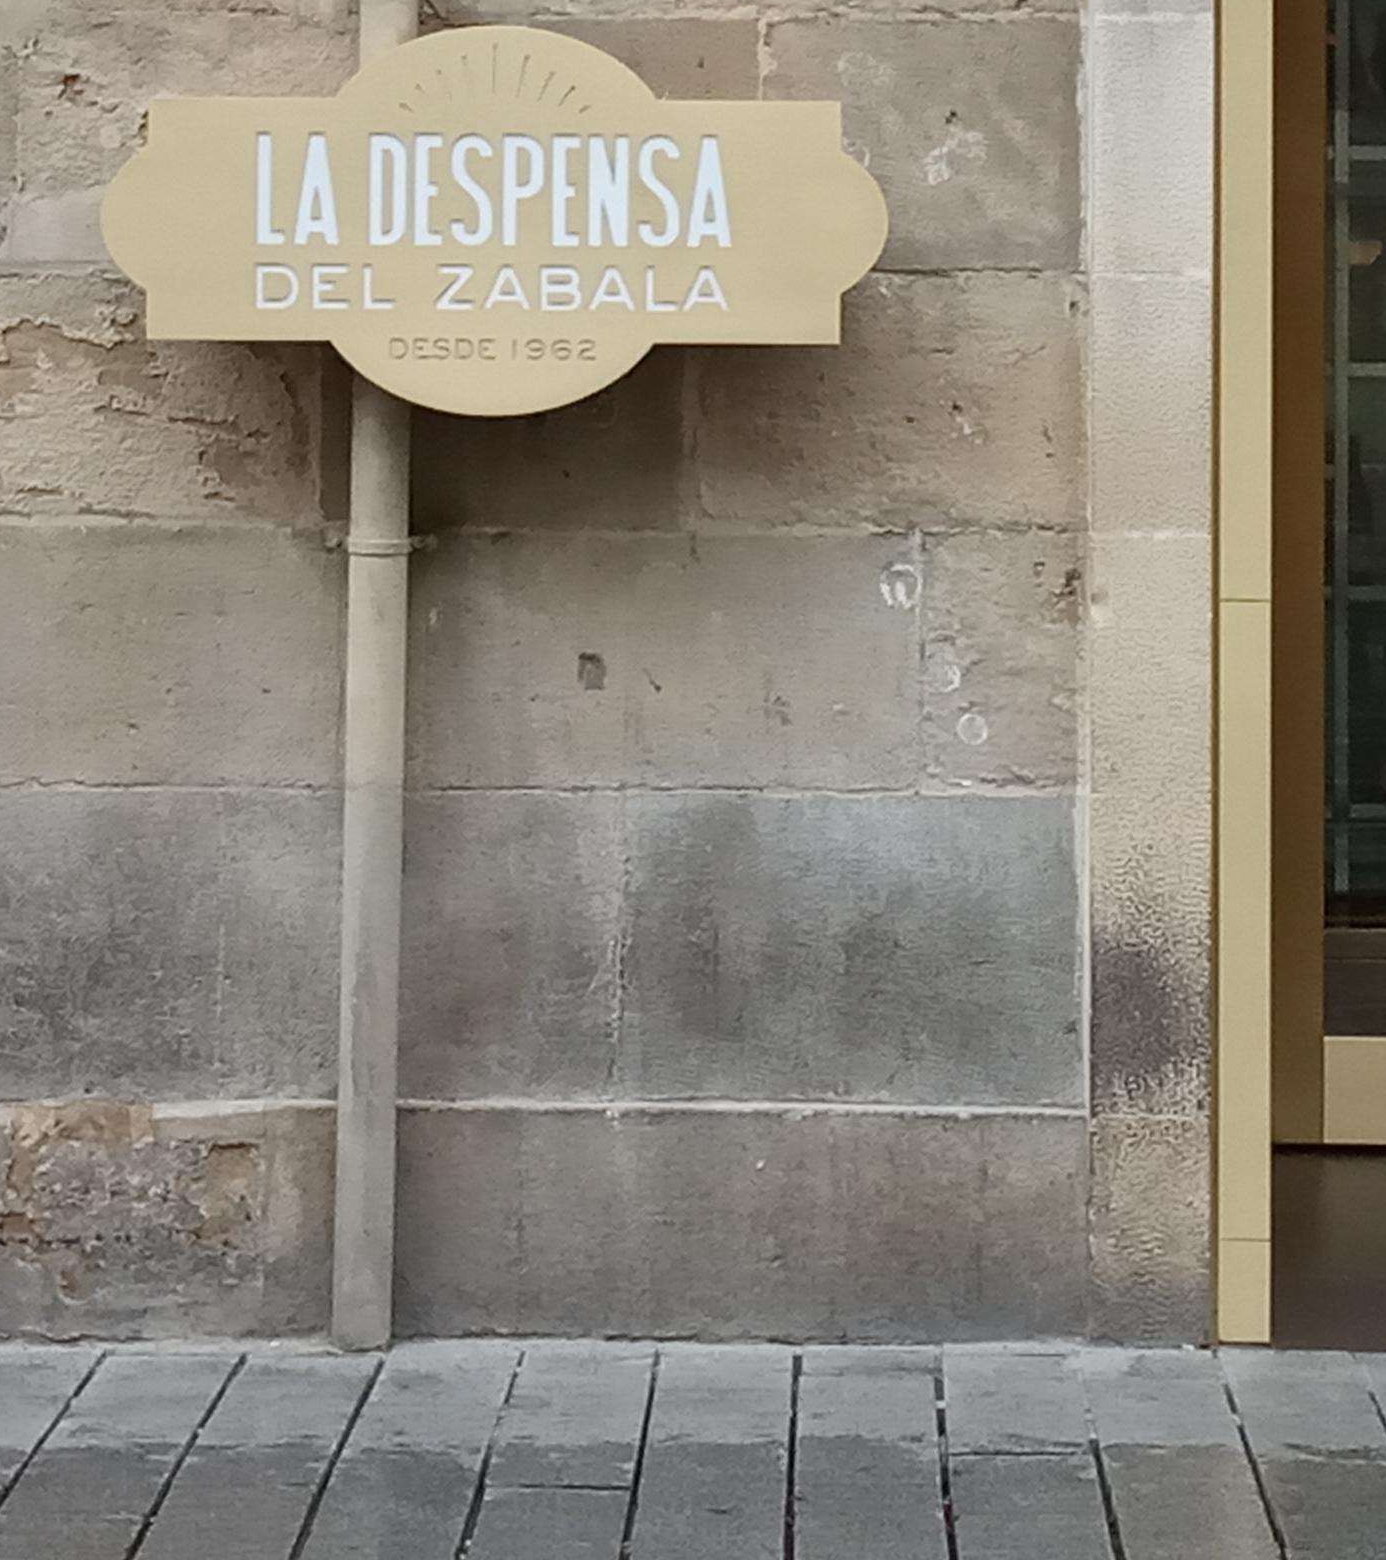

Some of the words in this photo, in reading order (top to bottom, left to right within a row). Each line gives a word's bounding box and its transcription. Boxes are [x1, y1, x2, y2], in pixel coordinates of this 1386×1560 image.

[254, 132, 339, 246] LA
[370, 133, 732, 248] DESPENSA
[255, 265, 396, 310] DEL
[436, 266, 730, 313] ZABALA
[388, 337, 497, 361] DESDE
[511, 338, 599, 362] 1962
